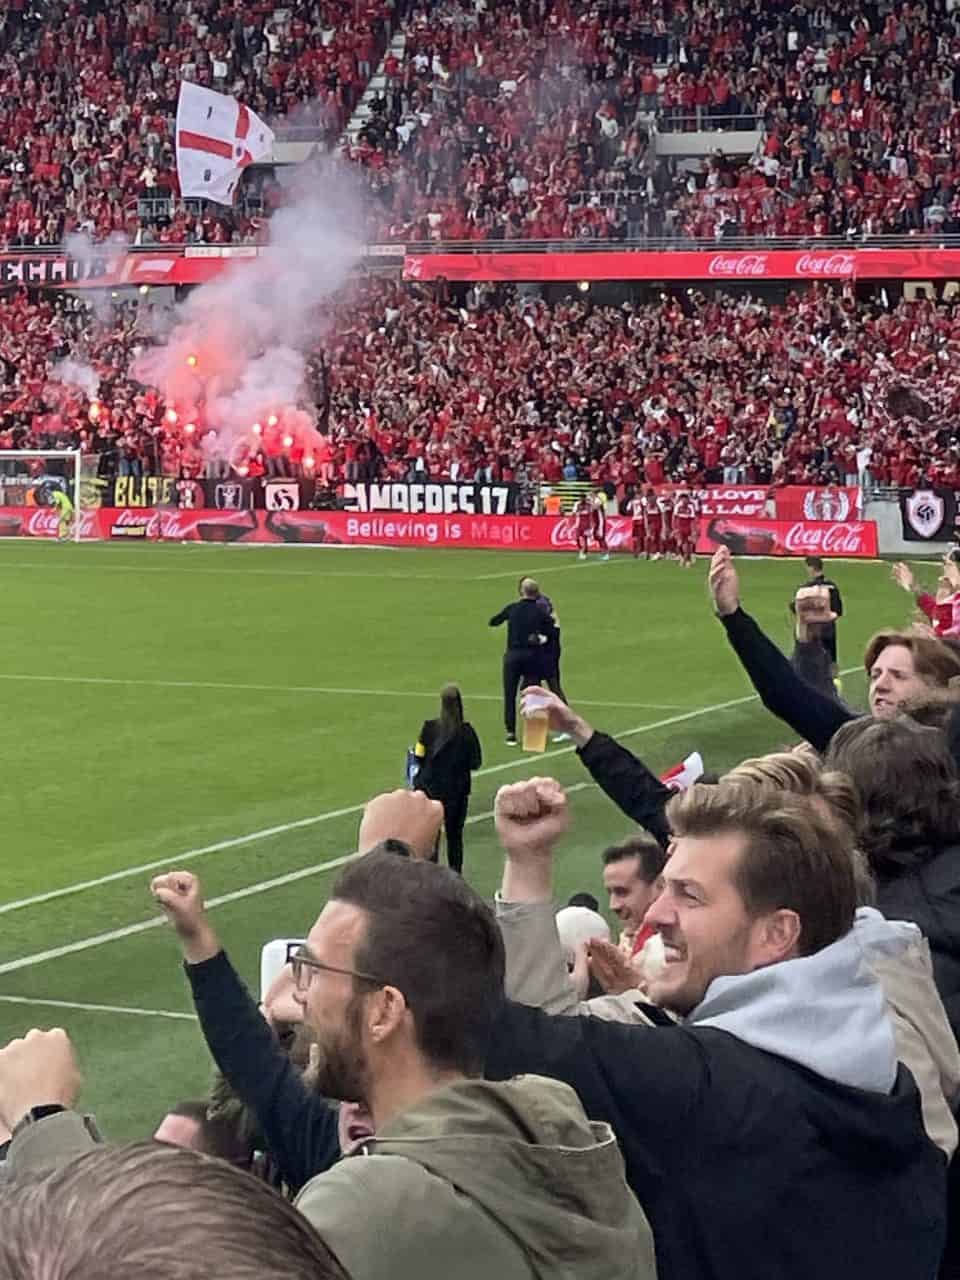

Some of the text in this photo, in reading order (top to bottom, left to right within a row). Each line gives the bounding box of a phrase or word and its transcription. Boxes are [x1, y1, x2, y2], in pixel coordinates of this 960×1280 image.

[480, 486, 509, 515] 17
[712, 489, 766, 500] LOVE
[346, 519, 532, 543] Believing is Magic
[784, 522, 865, 553] Coca-Cola
